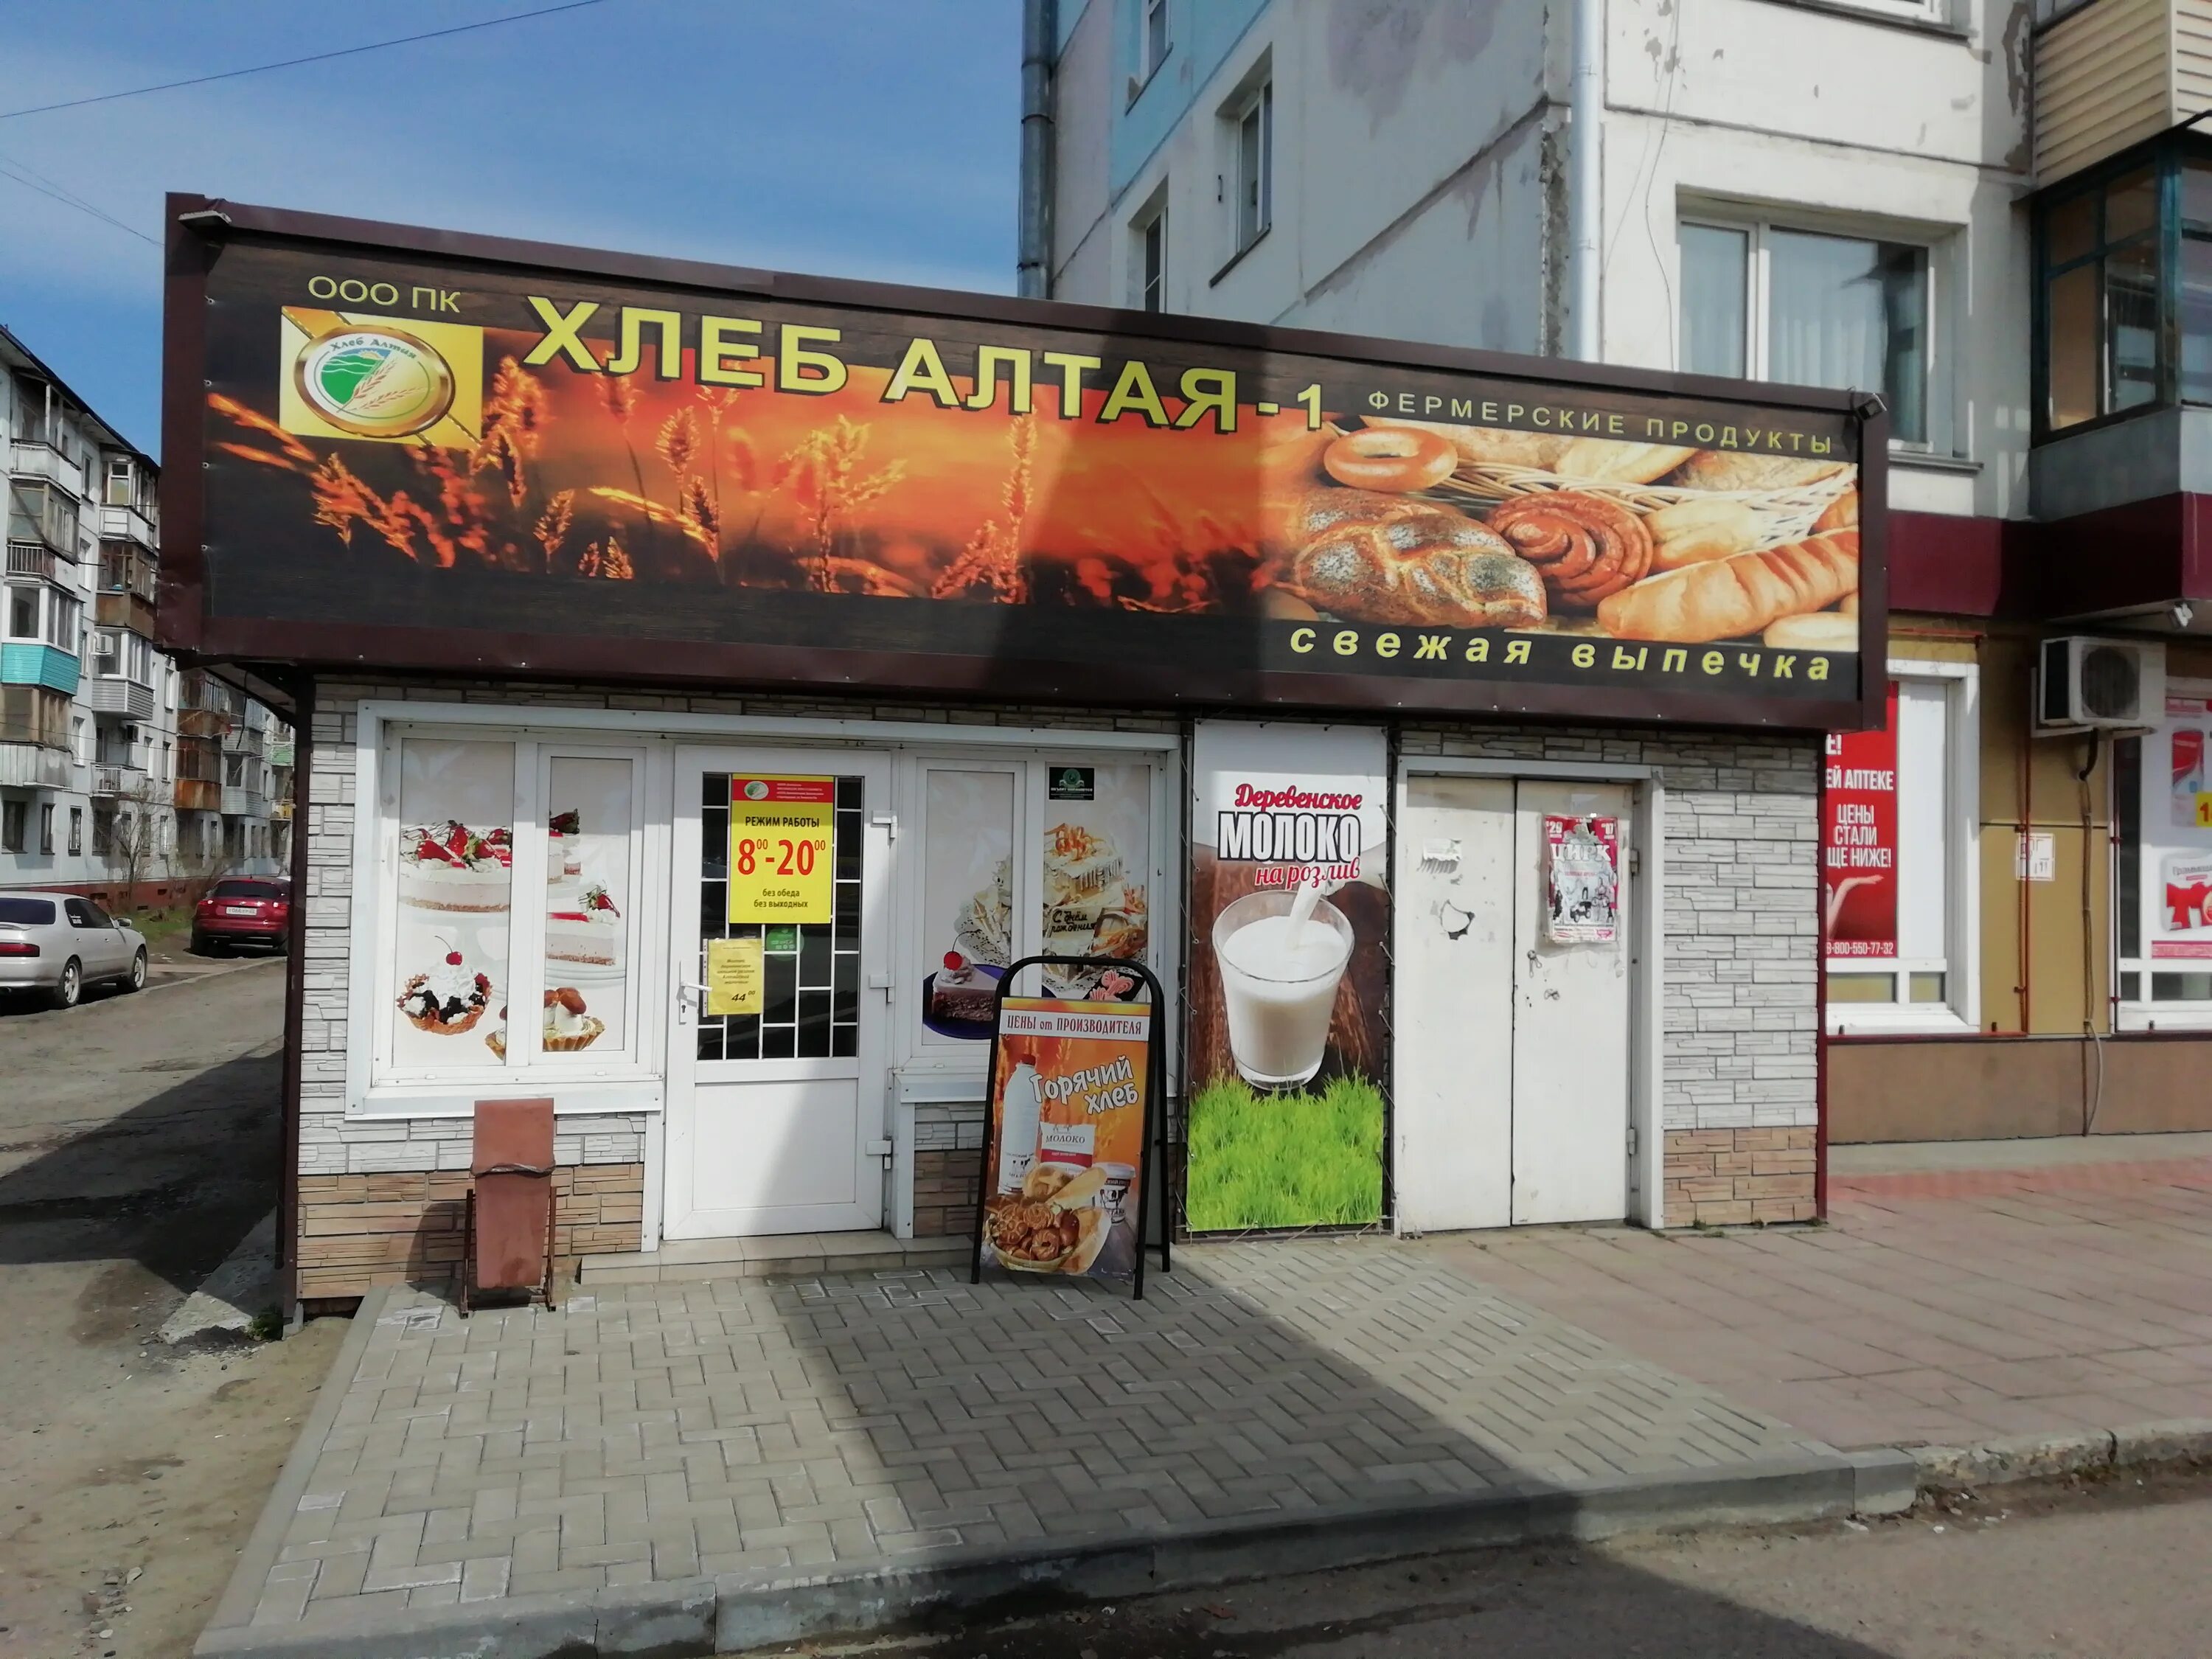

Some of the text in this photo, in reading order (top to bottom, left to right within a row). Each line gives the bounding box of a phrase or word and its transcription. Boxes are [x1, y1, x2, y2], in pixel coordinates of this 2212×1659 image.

[308, 276, 462, 313] ООО ПК
[330, 337, 364, 352] Хлеб
[523, 295, 849, 394] ХЛЕБ
[1366, 390, 1833, 455] ФЕРМЕРСКИЕ ПРОДУКТЫ
[1290, 625, 1831, 681] свежая выпечка
[1844, 769, 1894, 790] АПТЕКЕ
[1234, 783, 1363, 812] Деревенское
[745, 815, 820, 828] РЕЖИМ РАБОТЫ
[1837, 804, 1875, 825] ЦЕНЫ
[1217, 810, 1362, 863] МОЛОКО
[1834, 825, 1878, 846] СТАЛИ
[1550, 843, 1612, 862] ЦИРК
[1850, 847, 1892, 868] НИЖЕ!
[1255, 857, 1361, 891] на розлив
[762, 888, 800, 898] без обеда
[754, 900, 808, 909] без выходных
[1052, 910, 1062, 923] С
[1007, 1015, 1142, 1035] ЦЕНЫ от ПРОИЗВОДИТЕЛЯ
[1029, 1054, 1135, 1105] Горячий
[1083, 1082, 1139, 1116] хлеб
[1046, 1135, 1086, 1144] МОЛОКО
